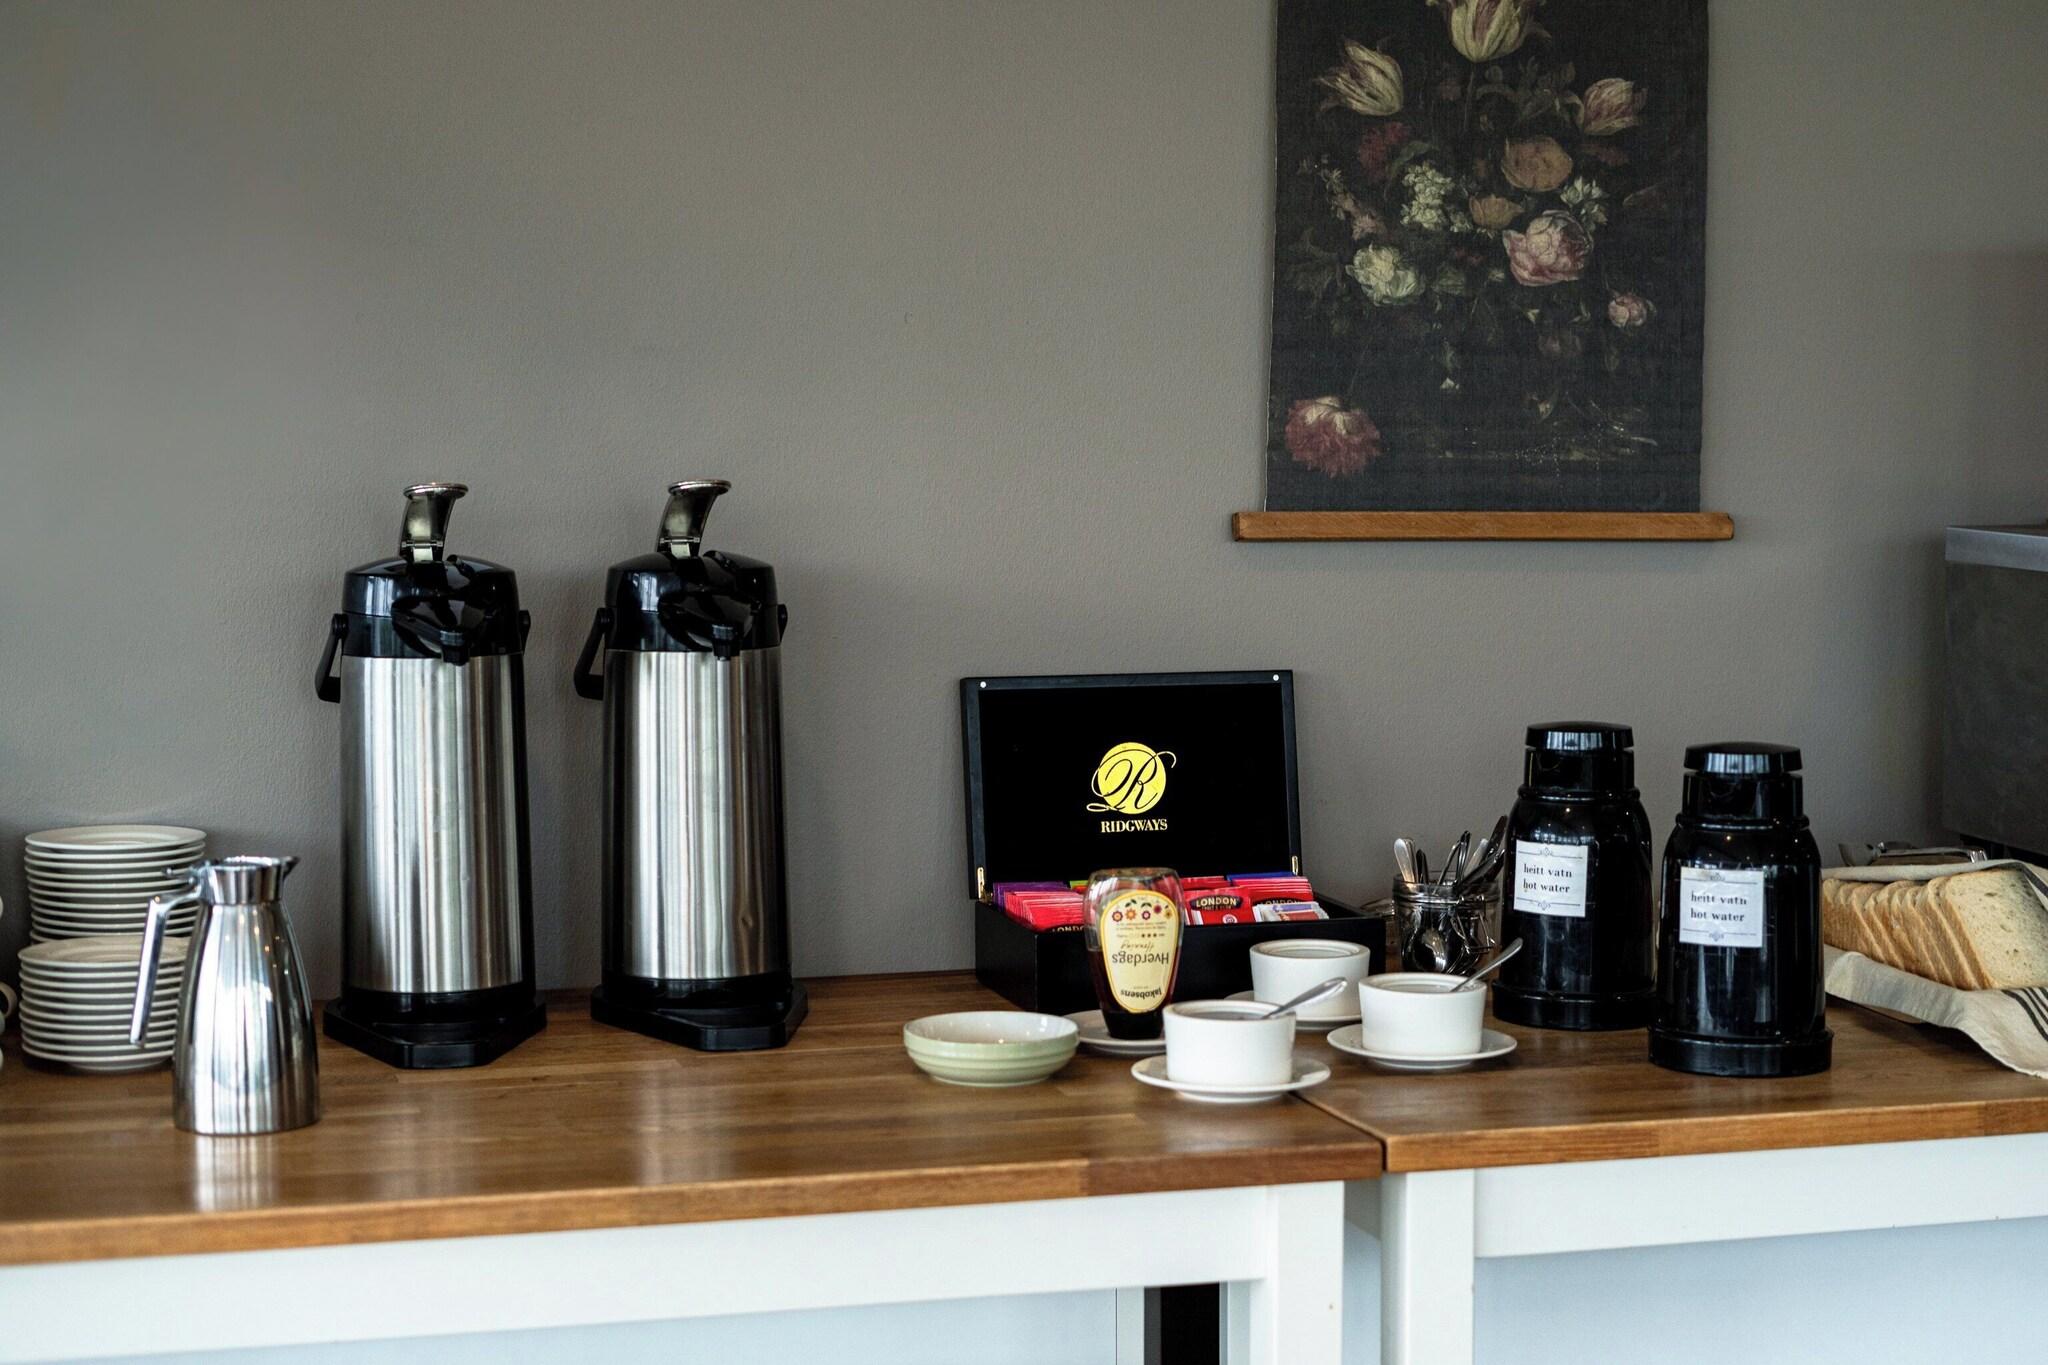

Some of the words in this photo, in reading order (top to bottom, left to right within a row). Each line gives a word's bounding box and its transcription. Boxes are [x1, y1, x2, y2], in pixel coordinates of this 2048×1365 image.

[1100, 818, 1168, 833] RIDGWAYS
[1523, 863, 1544, 875] heitt
[1548, 868, 1572, 878] vatn
[1523, 878, 1537, 890] hot
[1540, 882, 1571, 893] water
[1196, 896, 1237, 908] LONDON
[1690, 890, 1715, 903] heitt
[1720, 896, 1747, 905] vatn
[1690, 907, 1707, 919] hot
[1712, 912, 1745, 922] water
[1111, 950, 1169, 967] Hverdags
[1120, 987, 1162, 1000] Jakobsens
